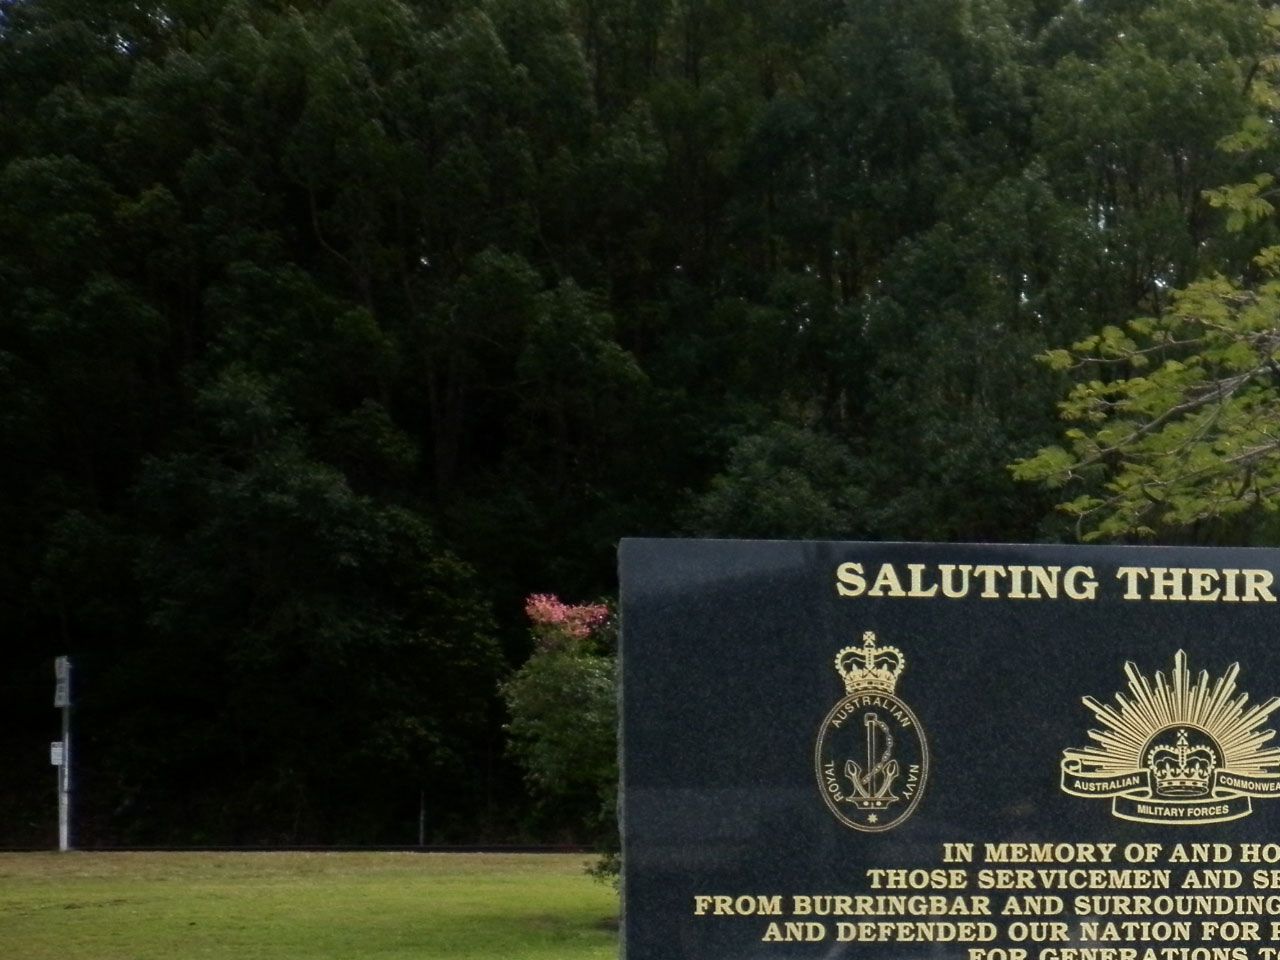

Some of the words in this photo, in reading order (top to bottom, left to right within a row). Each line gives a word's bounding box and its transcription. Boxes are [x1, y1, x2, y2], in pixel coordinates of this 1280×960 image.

[836, 561, 1099, 600] SALUTING
[1115, 566, 1278, 602] THEIR
[831, 696, 911, 729] AUSTRALIAN
[824, 760, 844, 802] ROYAL
[903, 764, 919, 800] NAVY
[1074, 776, 1140, 791] AUSTRALIAN
[1137, 805, 1185, 817] MILITARY
[1187, 805, 1229, 817] FORCES
[942, 842, 975, 863] IN
[984, 842, 1117, 863] MEMORY
[1124, 842, 1163, 863] OF
[1168, 843, 1233, 863] AND
[866, 868, 968, 890] THOSE
[977, 869, 1172, 890] SERVICEMEN
[1180, 869, 1243, 889] AND
[694, 895, 783, 916] FROM
[792, 895, 992, 916] BURRINGBAR
[1000, 895, 1064, 916] AND
[761, 921, 826, 942] AND
[835, 921, 998, 942] DEFENDED
[1007, 921, 1071, 942] OUR
[1079, 921, 1192, 942] NATION
[1201, 921, 1262, 942] FOR
